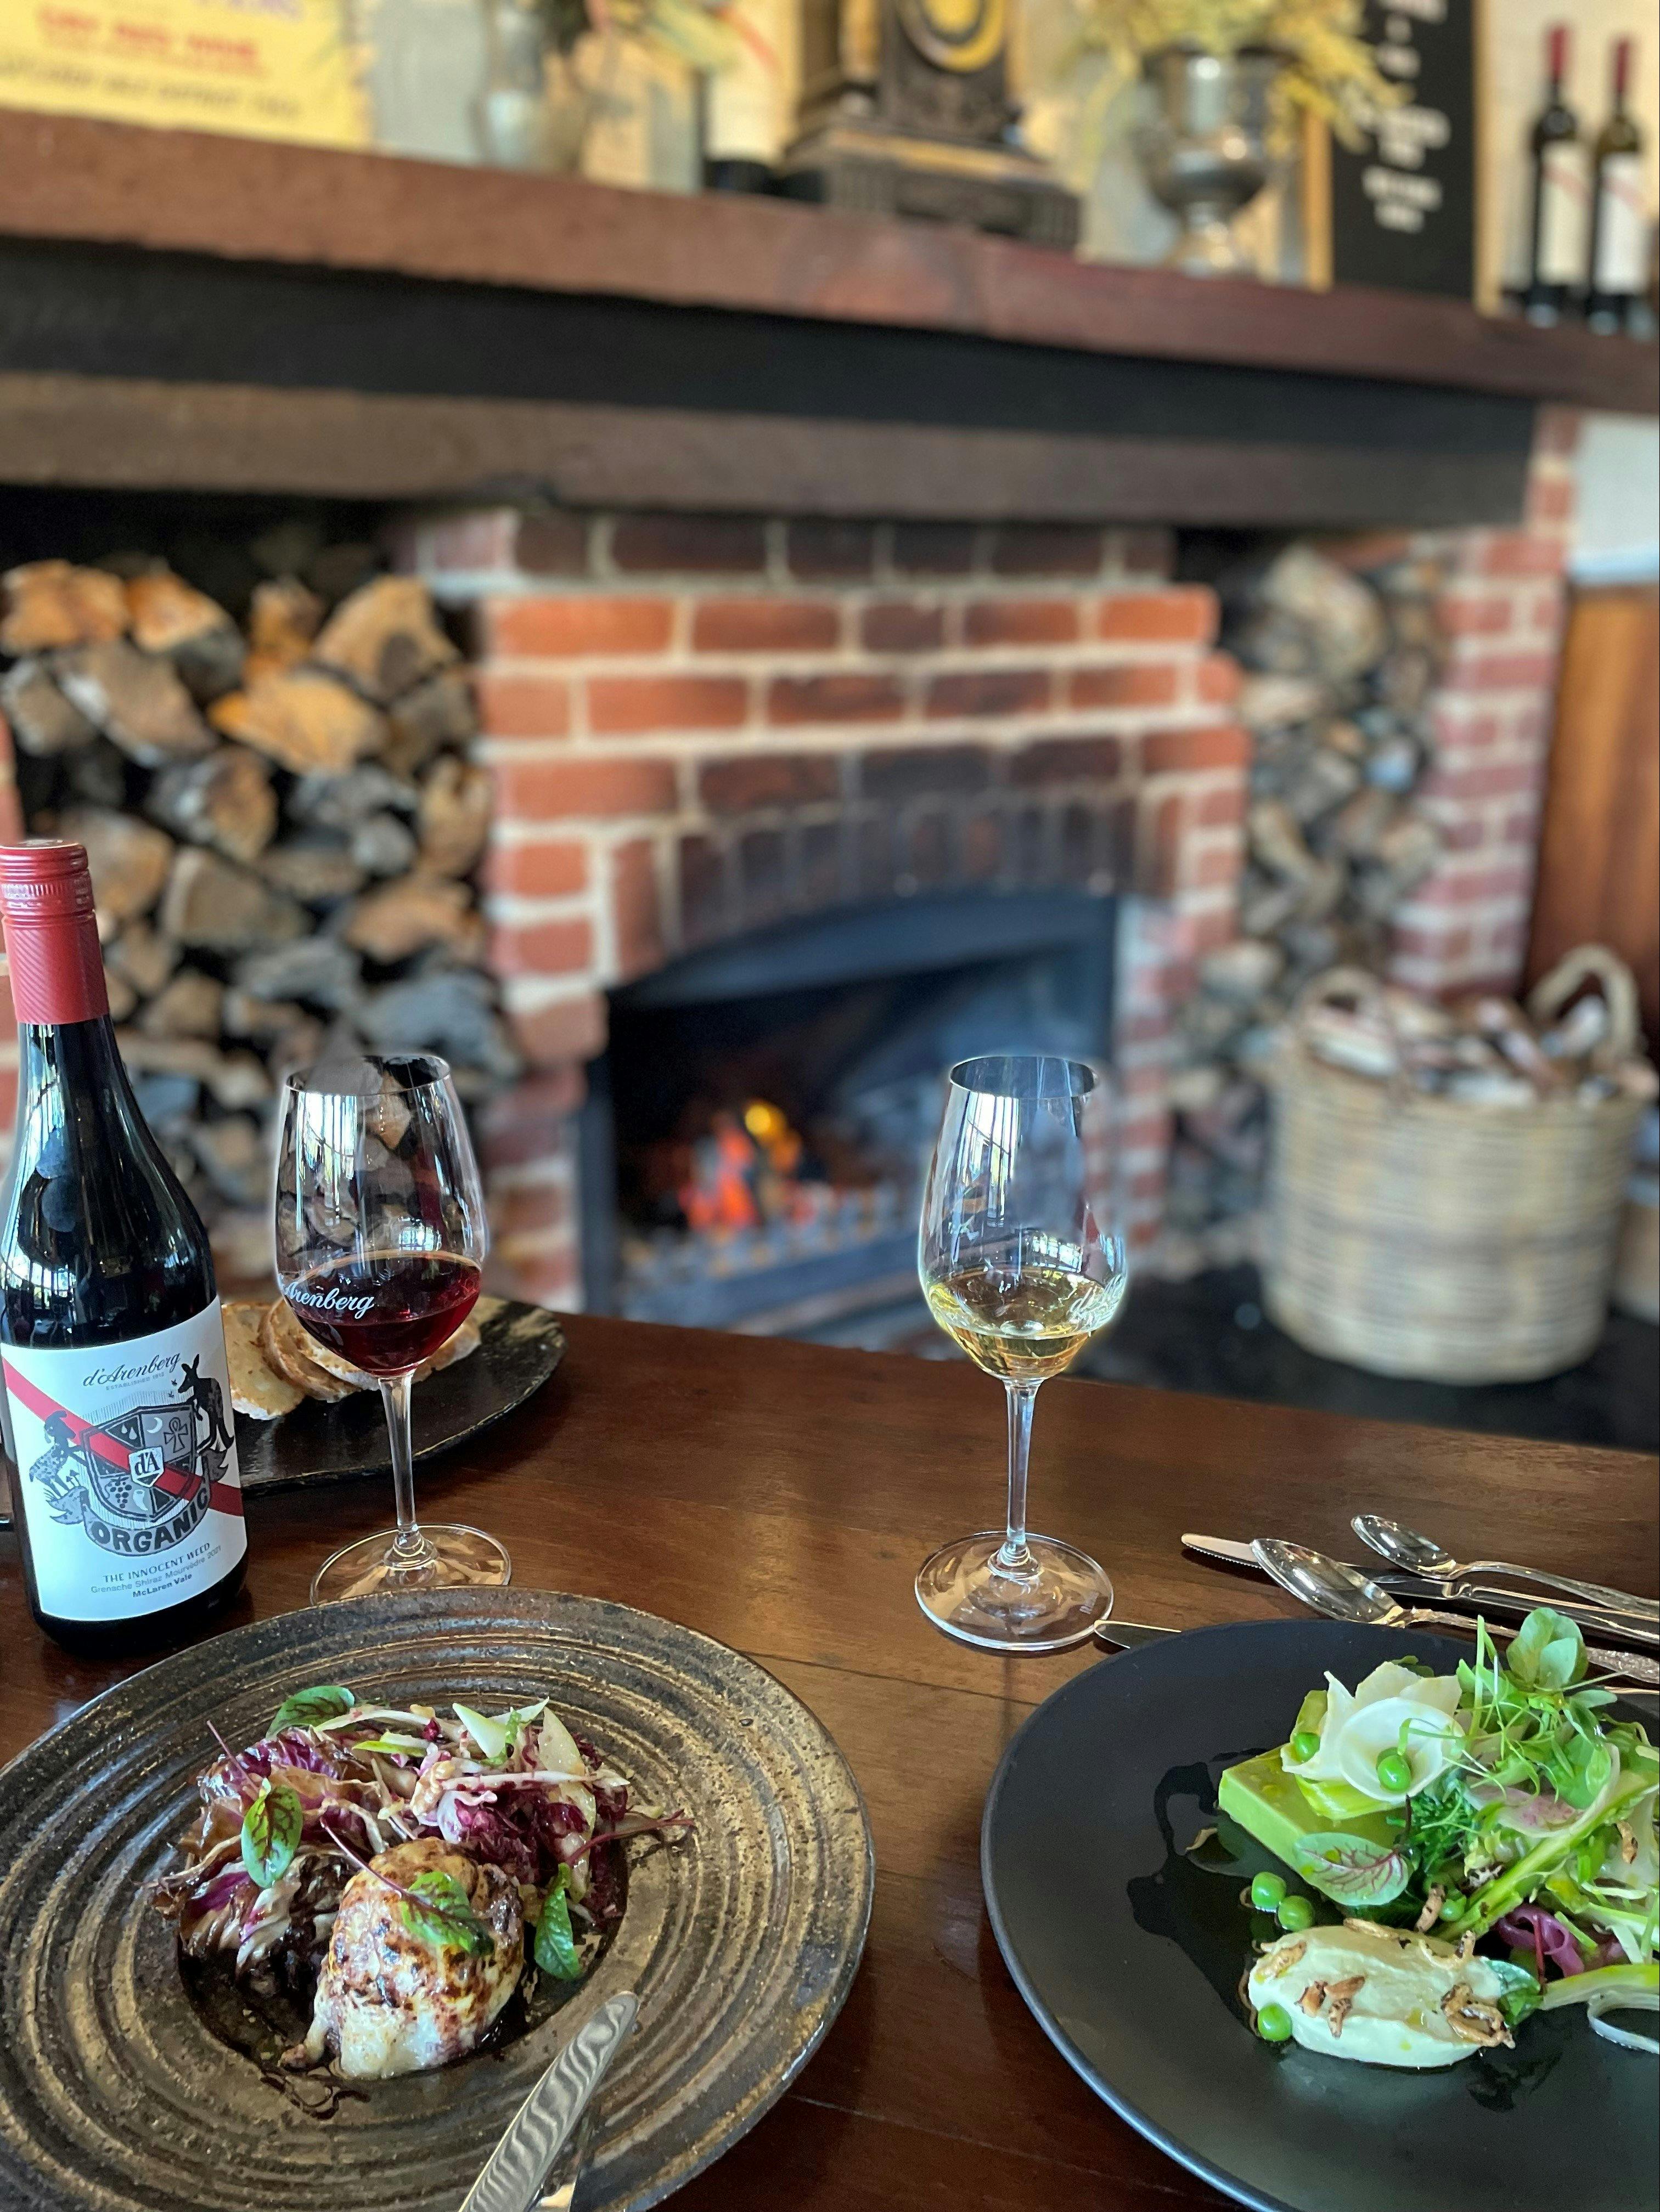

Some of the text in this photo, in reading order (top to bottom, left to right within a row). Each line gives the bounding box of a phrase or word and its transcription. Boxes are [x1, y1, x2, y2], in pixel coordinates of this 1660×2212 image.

[83, 1353, 181, 1387] d'Arenberg
[91, 1487, 209, 1553] ORGANIC
[103, 1543, 210, 1583] THE INNOCENT WEED
[91, 1583, 133, 1593] Grenache
[135, 1575, 163, 1588] Shiraz
[132, 1573, 192, 1598] McLaren Vale
